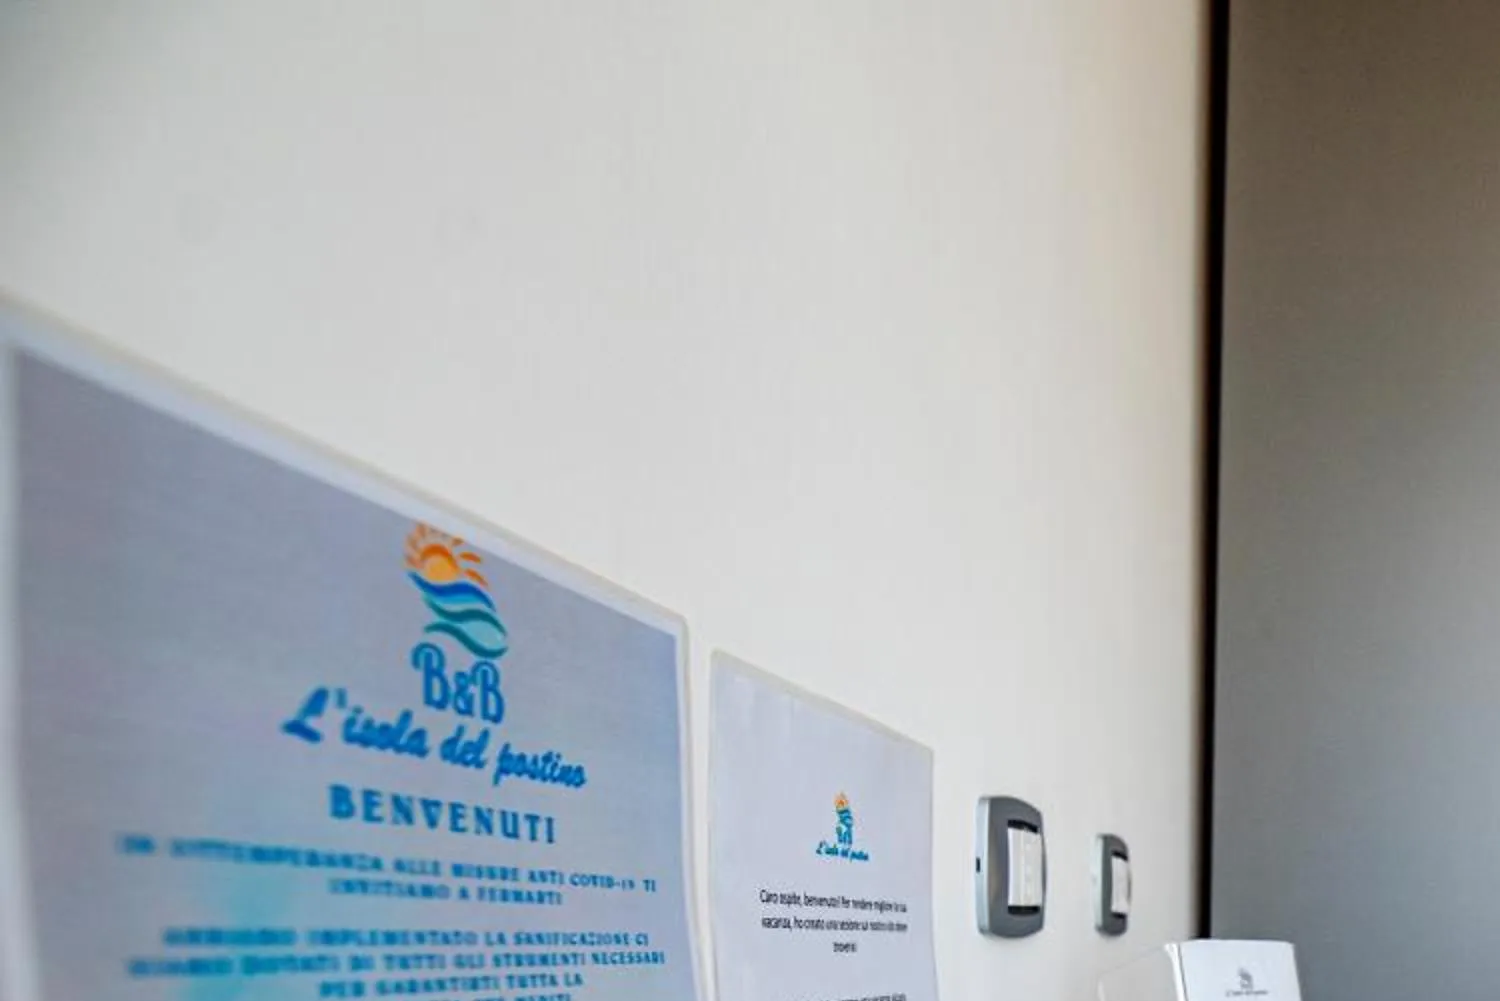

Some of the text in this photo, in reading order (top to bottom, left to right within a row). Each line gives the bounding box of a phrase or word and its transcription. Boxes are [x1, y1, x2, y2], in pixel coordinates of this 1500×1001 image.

[411, 642, 505, 724] B&B
[282, 686, 587, 788] L'isola del postino
[329, 784, 556, 844] BENVENUTI
[528, 870, 565, 886] ANTI
[485, 931, 507, 946] LA
